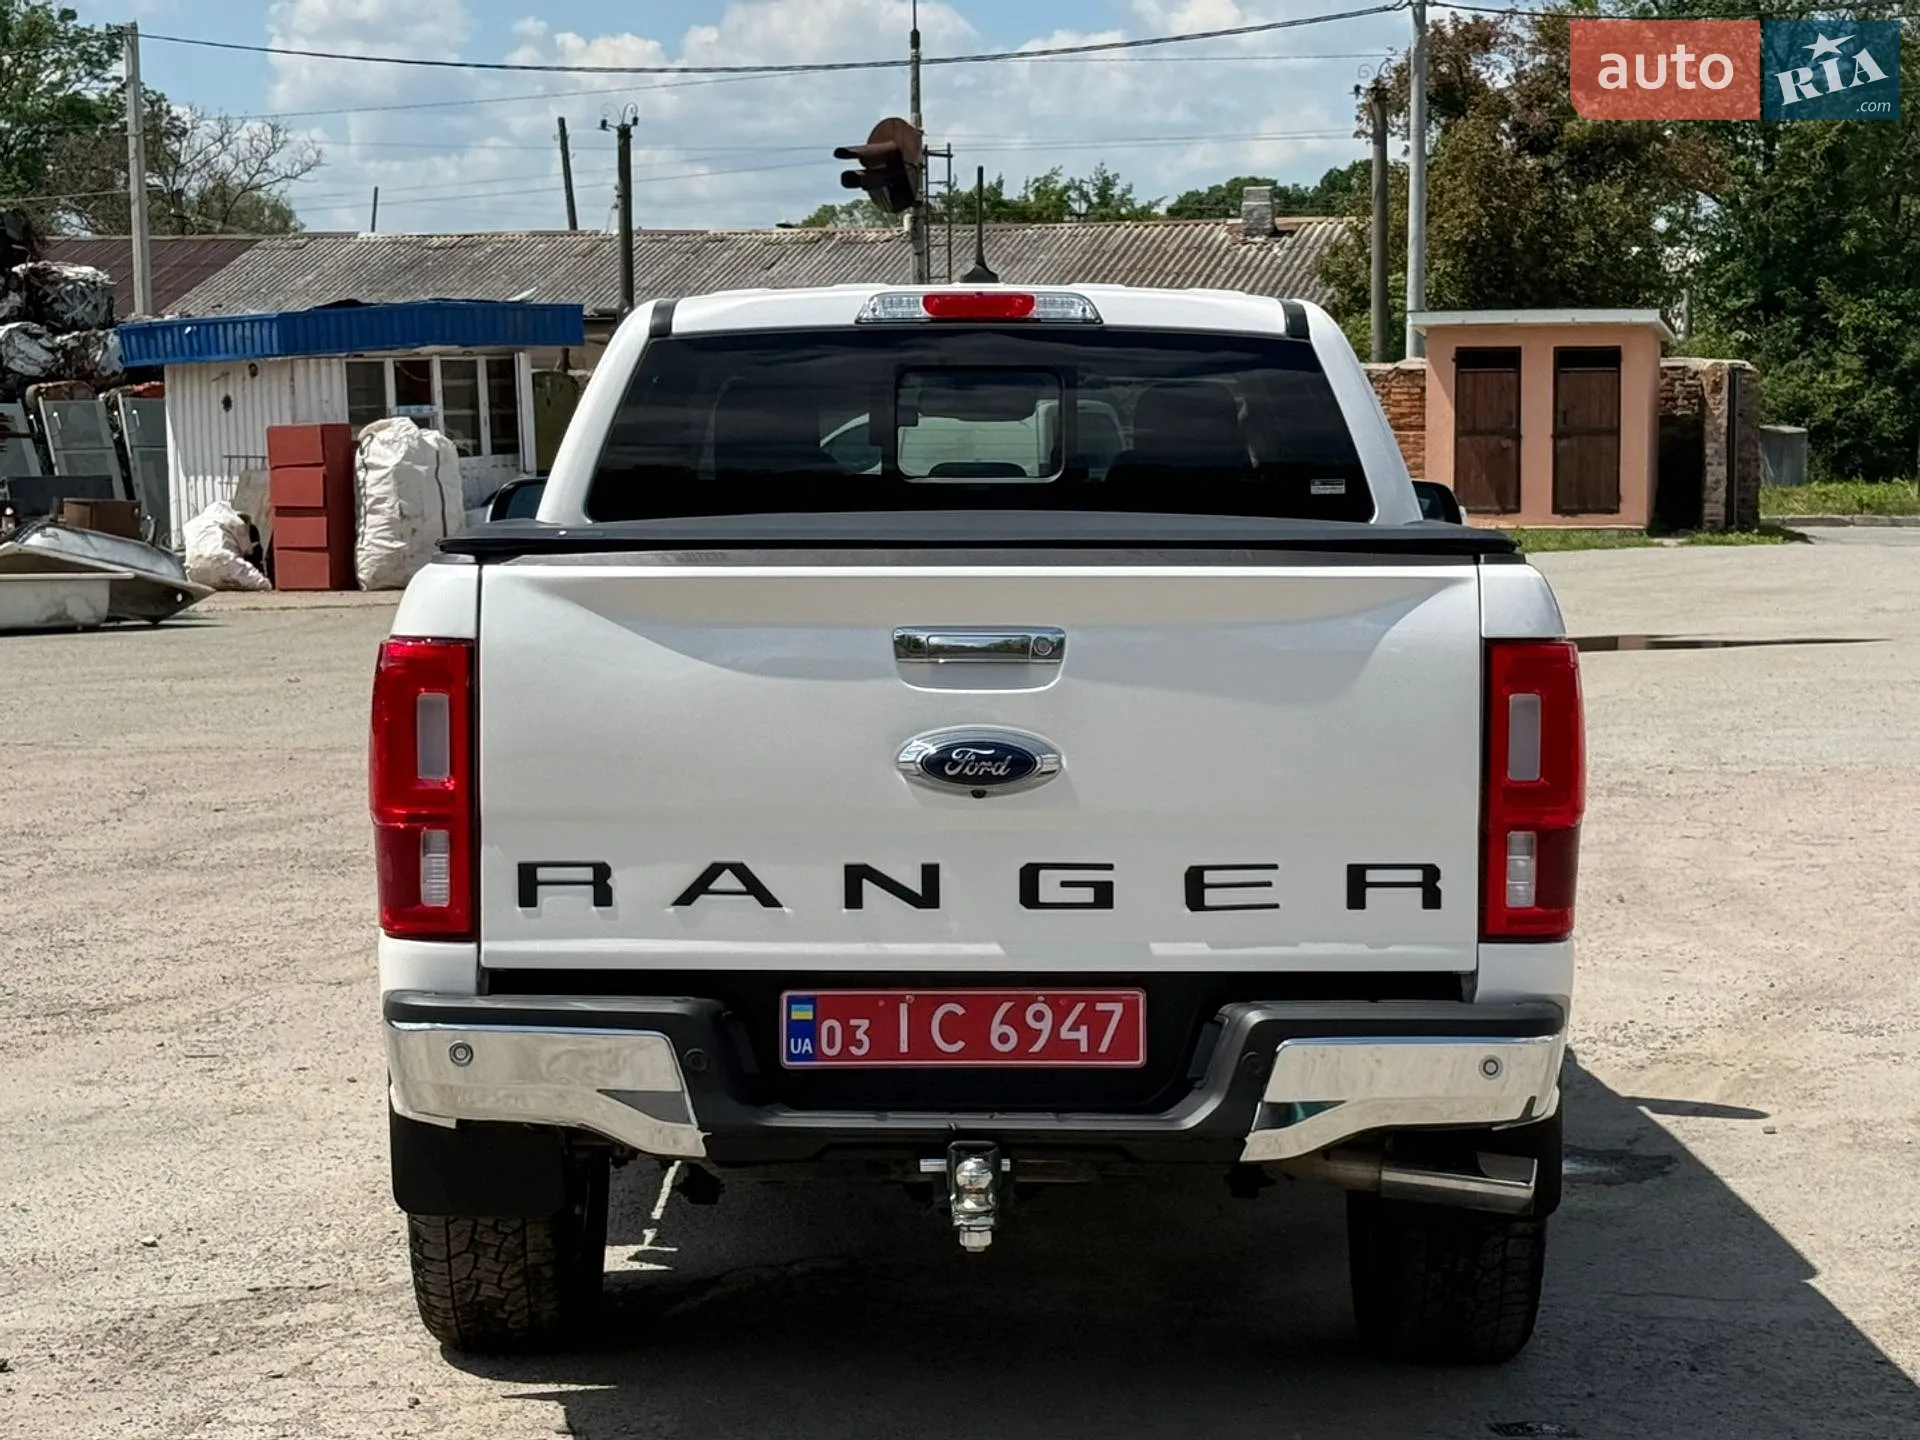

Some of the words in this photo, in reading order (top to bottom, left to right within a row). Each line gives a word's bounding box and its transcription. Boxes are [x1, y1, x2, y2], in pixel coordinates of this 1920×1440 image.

[944, 748, 1012, 776] Ford
[517, 861, 1442, 912] RANGER
[790, 1038, 813, 1055] UA
[820, 1019, 870, 1056] 03
[989, 1002, 1124, 1053] 6947
